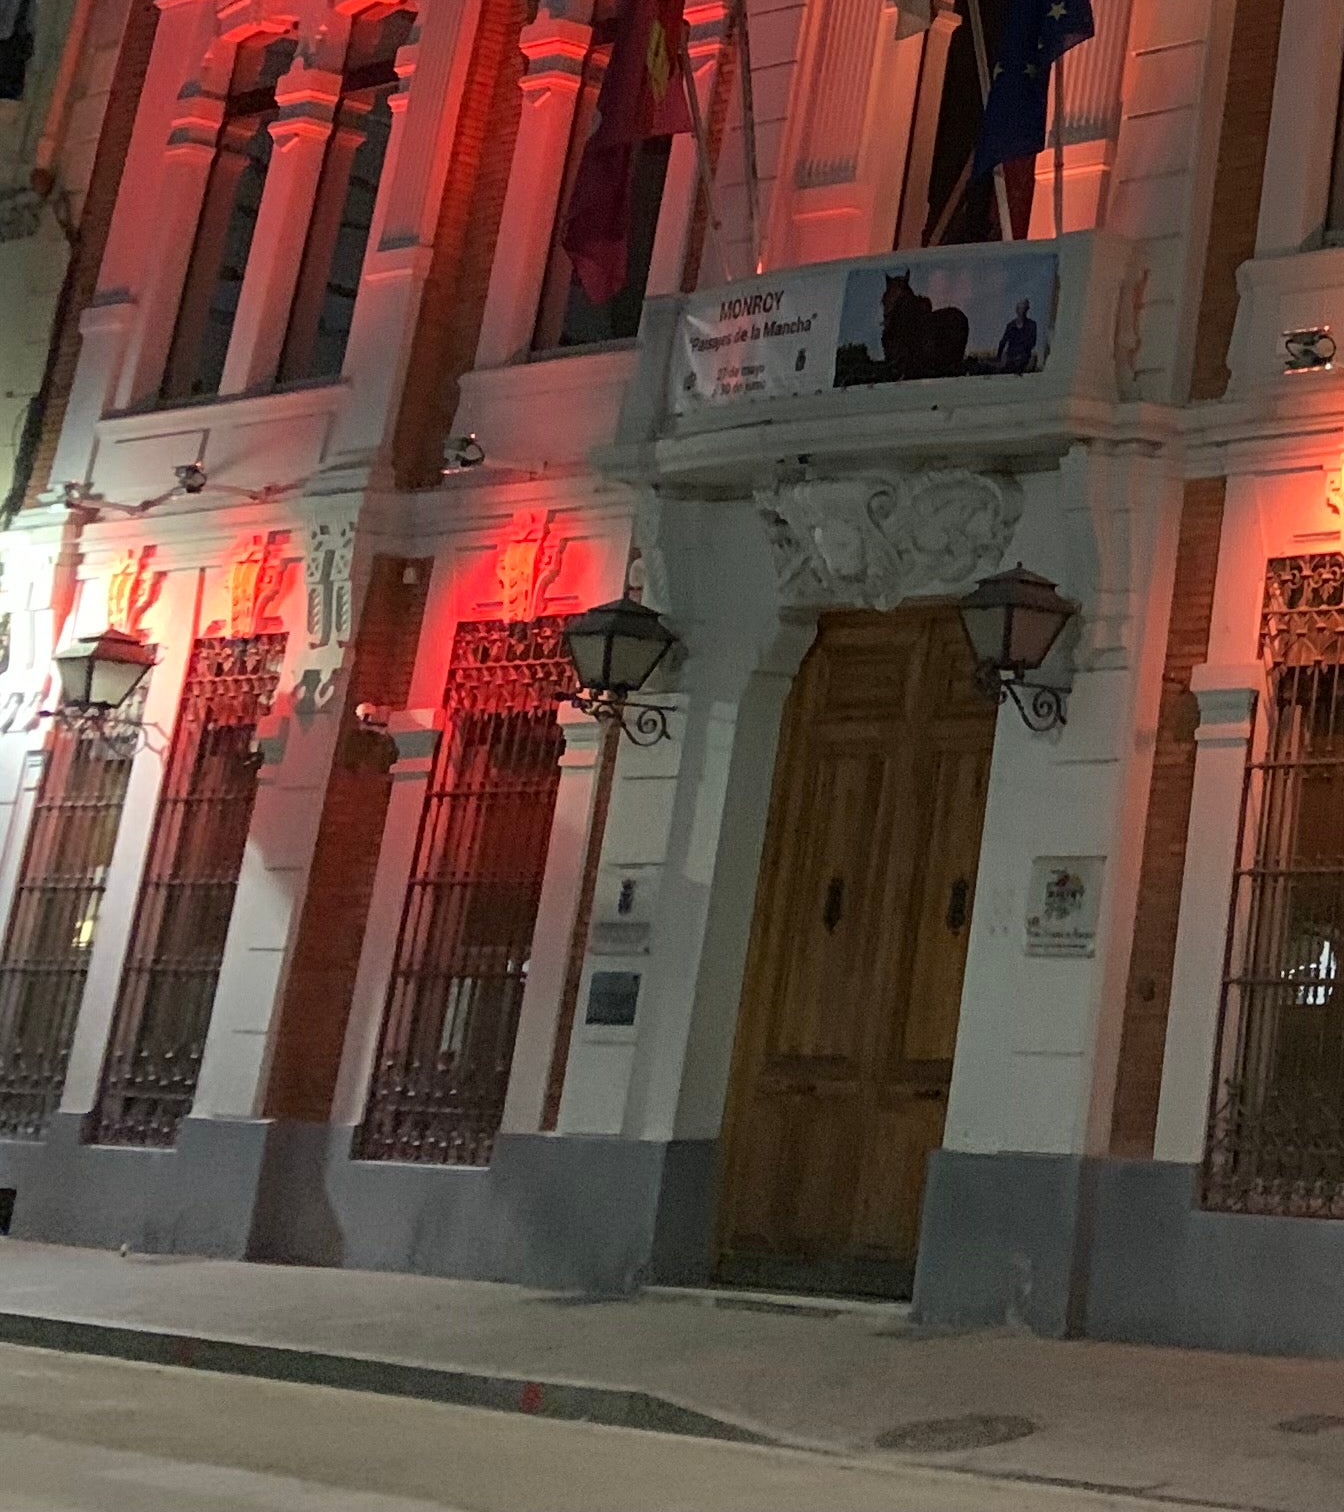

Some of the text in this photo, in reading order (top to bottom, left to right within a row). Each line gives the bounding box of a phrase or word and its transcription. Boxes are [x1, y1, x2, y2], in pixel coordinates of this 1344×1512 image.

[720, 290, 785, 321] MONROY
[734, 328, 749, 344] de
[751, 324, 761, 339] la
